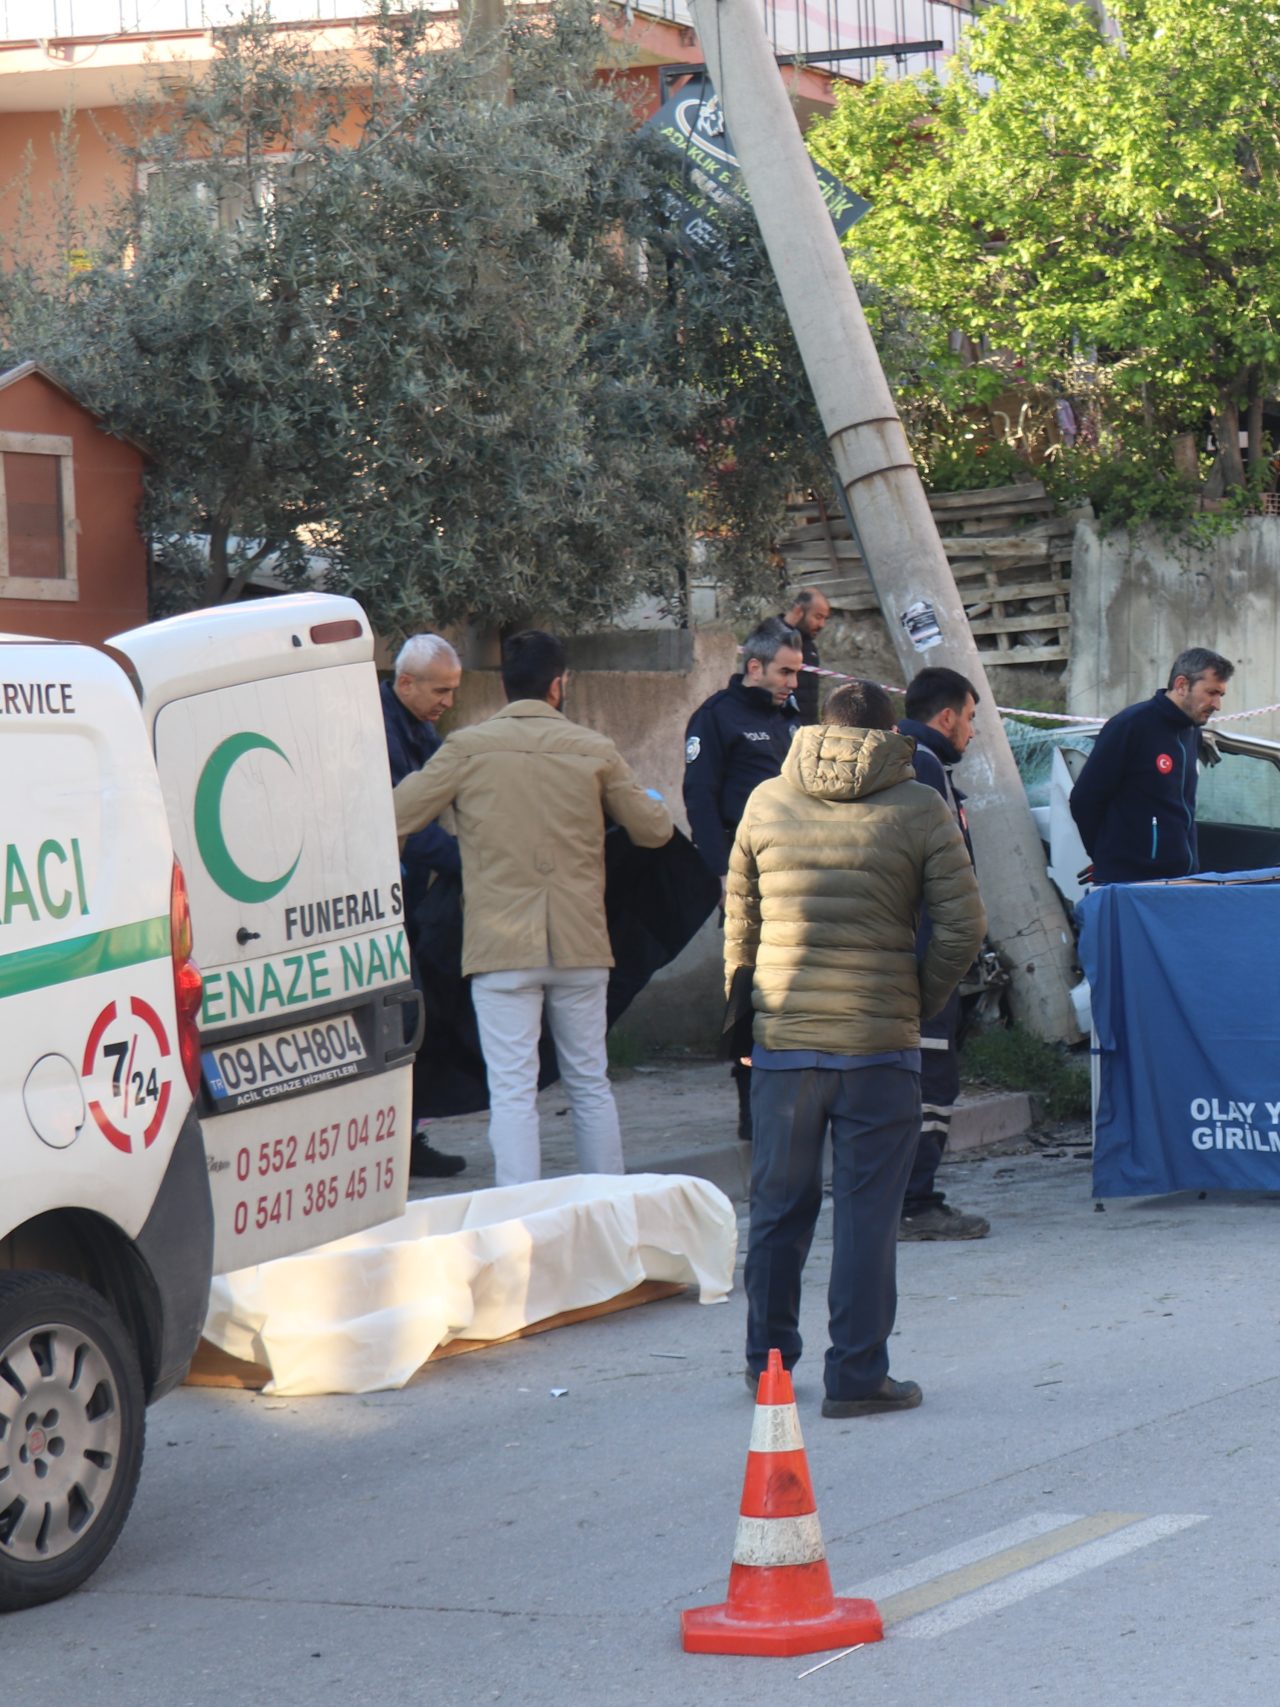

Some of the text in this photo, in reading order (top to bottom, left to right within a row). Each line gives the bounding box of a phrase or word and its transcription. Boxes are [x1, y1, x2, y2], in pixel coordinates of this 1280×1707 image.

[0, 683, 76, 714] RVICE
[0, 838, 90, 925] ACI
[285, 888, 386, 941] FUNERAL
[201, 931, 410, 1025] ENAZE NAK
[210, 1079, 224, 1091] TR
[218, 1020, 362, 1091] 09ACH804
[237, 1063, 359, 1106] ACİL CENAZE HİZMETLERİ
[1190, 1097, 1256, 1124] OLAY
[237, 1147, 250, 1181] 0
[257, 1135, 298, 1176] 552
[304, 1122, 341, 1164] 457
[347, 1114, 369, 1151] 04
[375, 1105, 397, 1142] 22
[234, 1156, 394, 1235] 0 541 385 45 15
